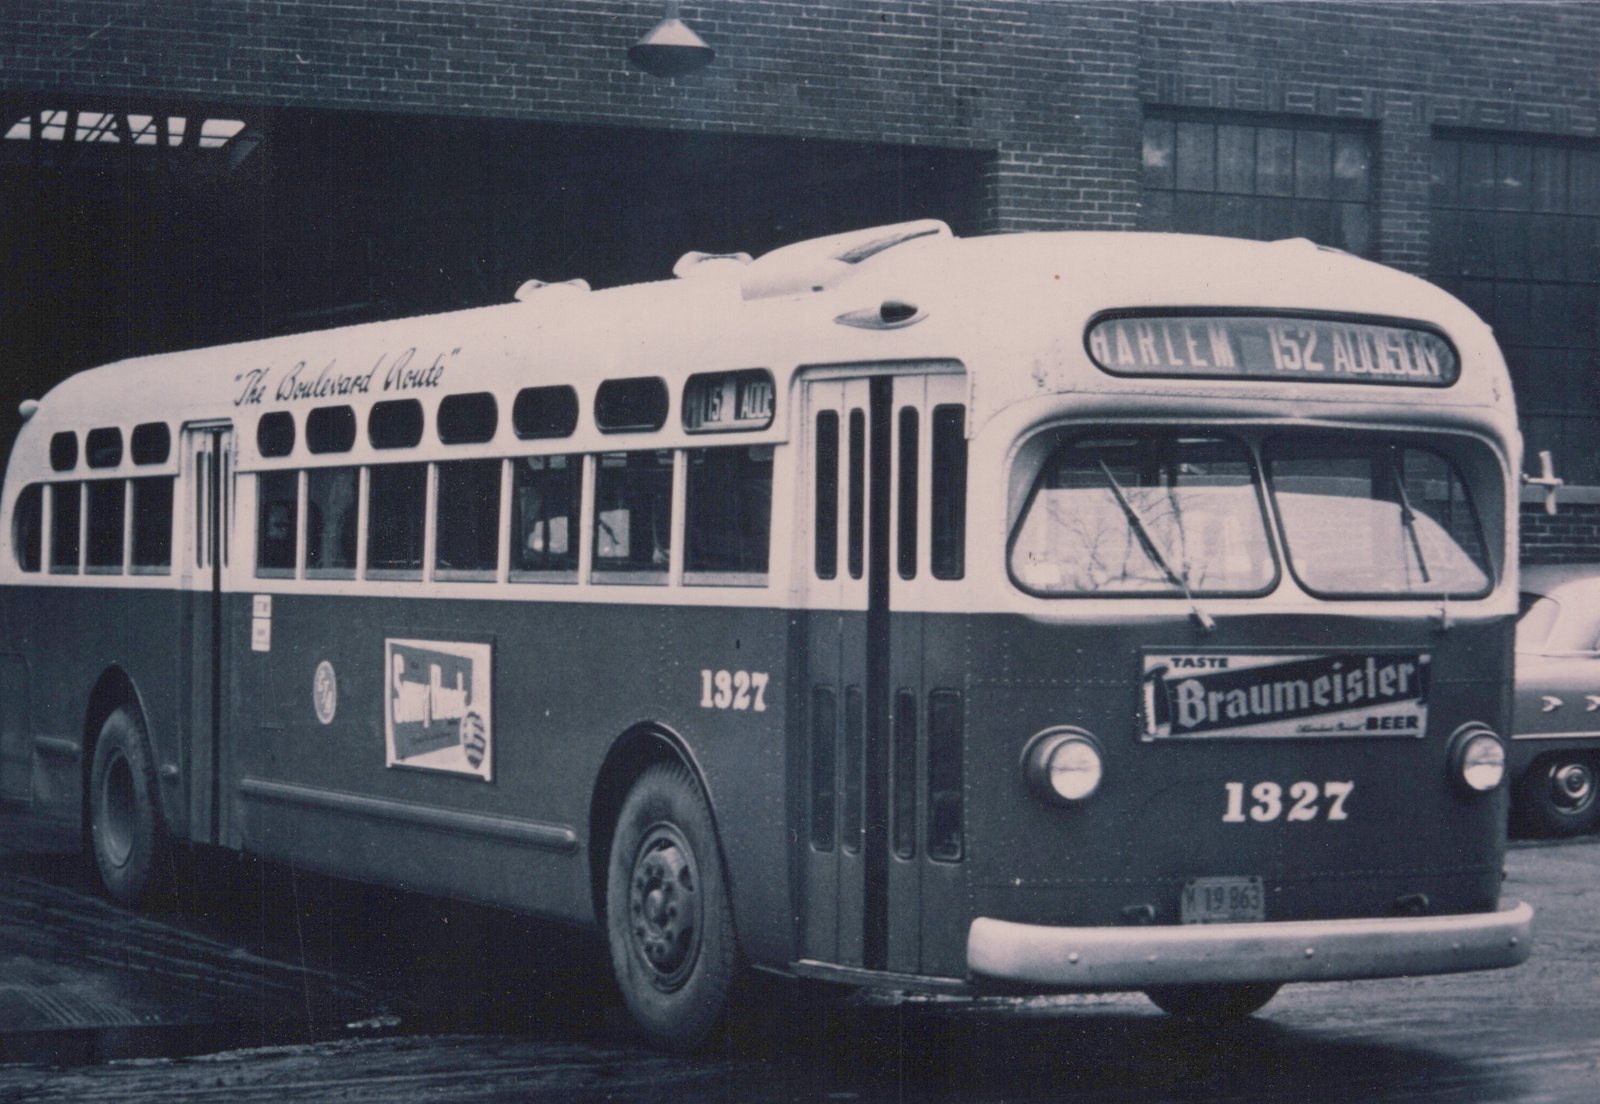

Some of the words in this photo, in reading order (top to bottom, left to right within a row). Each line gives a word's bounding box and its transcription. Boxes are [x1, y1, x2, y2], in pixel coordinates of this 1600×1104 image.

[1090, 321, 1236, 368] HARLEM
[1267, 324, 1325, 371] 152
[1332, 328, 1440, 377] ADDISON
[275, 352, 387, 402] Boulevard
[1170, 657, 1229, 669] TASTE
[700, 669, 769, 712] 1327
[1176, 657, 1415, 729] Braumeister
[1364, 715, 1419, 731] BEER
[1222, 781, 1354, 823] 1327
